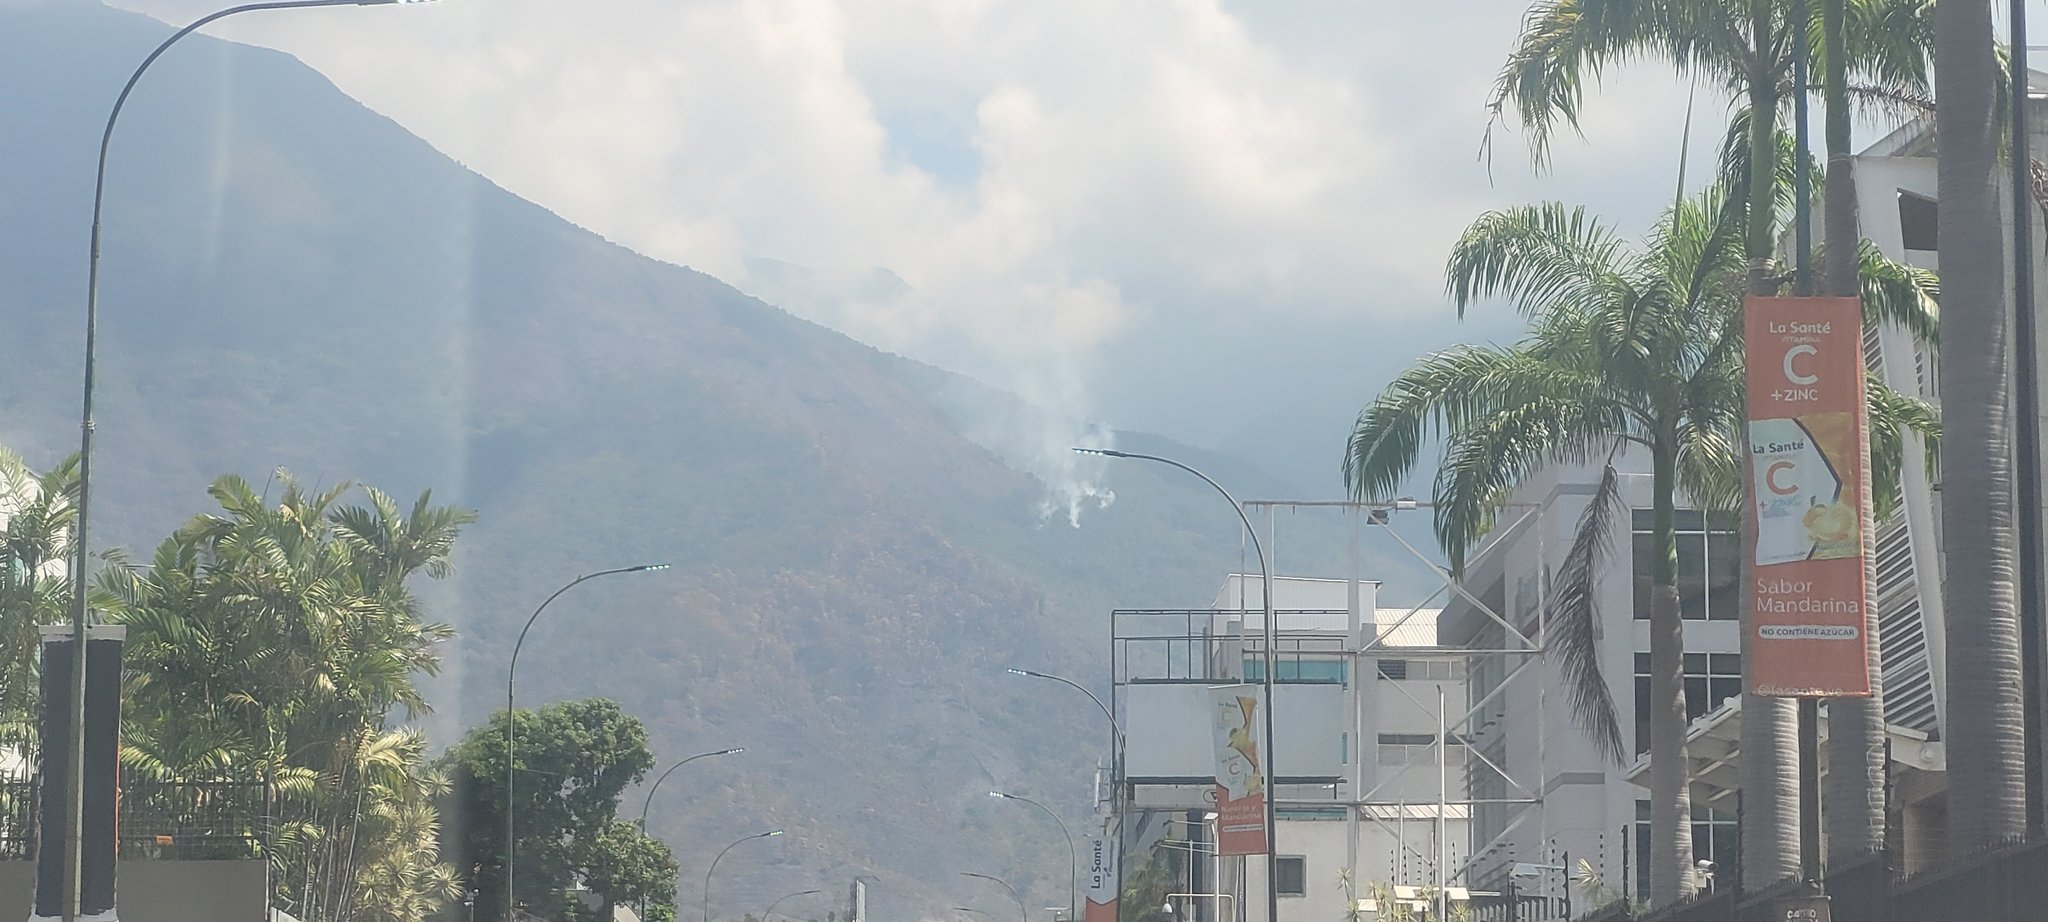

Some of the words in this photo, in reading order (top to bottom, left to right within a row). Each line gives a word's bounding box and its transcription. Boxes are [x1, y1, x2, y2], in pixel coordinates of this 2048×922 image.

[1769, 321, 1786, 334] La
[1790, 321, 1831, 334] Santé
[1783, 344, 1819, 385] C
[1753, 443, 1765, 454] La
[1768, 439, 1805, 453] Santé
[1766, 461, 1799, 495] C
[1757, 578, 1813, 594] Sabor
[1757, 598, 1859, 614] Mandarina
[1761, 628, 1775, 636] NO
[1776, 628, 1819, 636] CONTIENE
[1820, 626, 1855, 636] AZÚCAR
[1091, 840, 1102, 873] Santé
[1091, 875, 1101, 889] La
